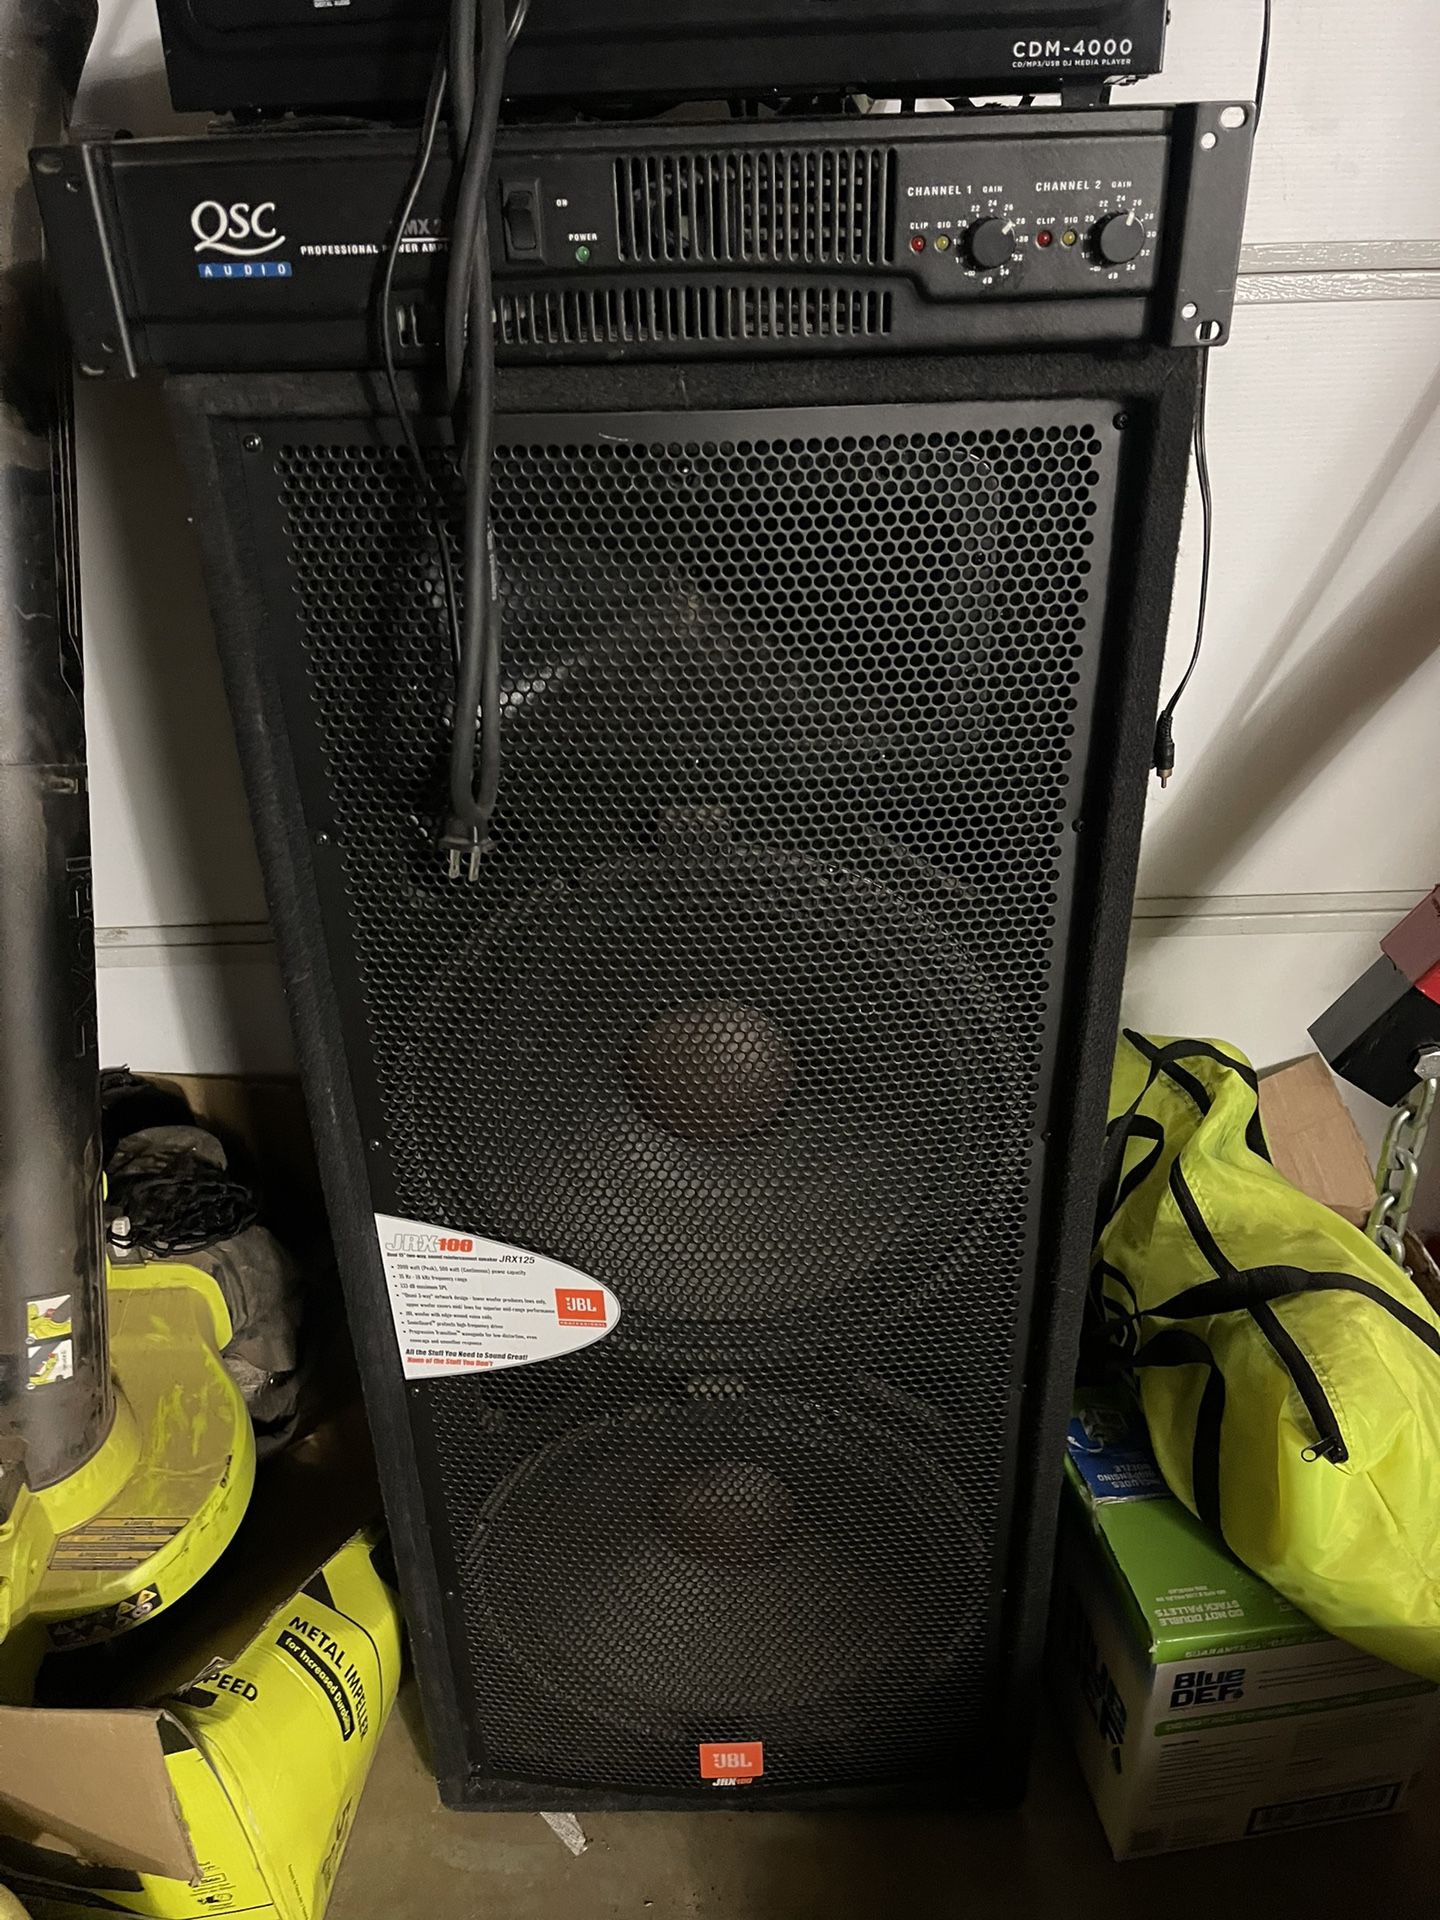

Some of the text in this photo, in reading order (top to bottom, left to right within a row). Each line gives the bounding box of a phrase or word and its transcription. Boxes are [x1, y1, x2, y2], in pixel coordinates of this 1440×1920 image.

[1013, 39, 1132, 58] CDM-4000
[1012, 58, 1131, 68] CD/MP3/USB DJ MEDIA PLAYER
[907, 184, 972, 197] CHANNEL 1
[982, 185, 1003, 193] GAIN
[1035, 180, 1101, 192] CHANNEL 2
[556, 198, 568, 207] ON
[910, 222, 929, 230] CLIP
[1036, 217, 1056, 225] CLIP
[190, 200, 286, 256] QSC
[568, 232, 598, 242] POWER
[300, 243, 379, 256] PROFESSIONAL
[204, 263, 286, 278] AUDIO
[499, 1255, 535, 1264] JRX125
[566, 1296, 597, 1312] JBL
[458, 1350, 475, 1358] Need
[1154, 1600, 1240, 1617] STACK PALLETS
[1159, 1608, 1244, 1627] DO NOT DOUBLE
[288, 1616, 345, 1670] METAL
[284, 1637, 301, 1652] for
[300, 1649, 339, 1695] Increased
[201, 1671, 259, 1702] PEED
[712, 1752, 753, 1769] JBL
